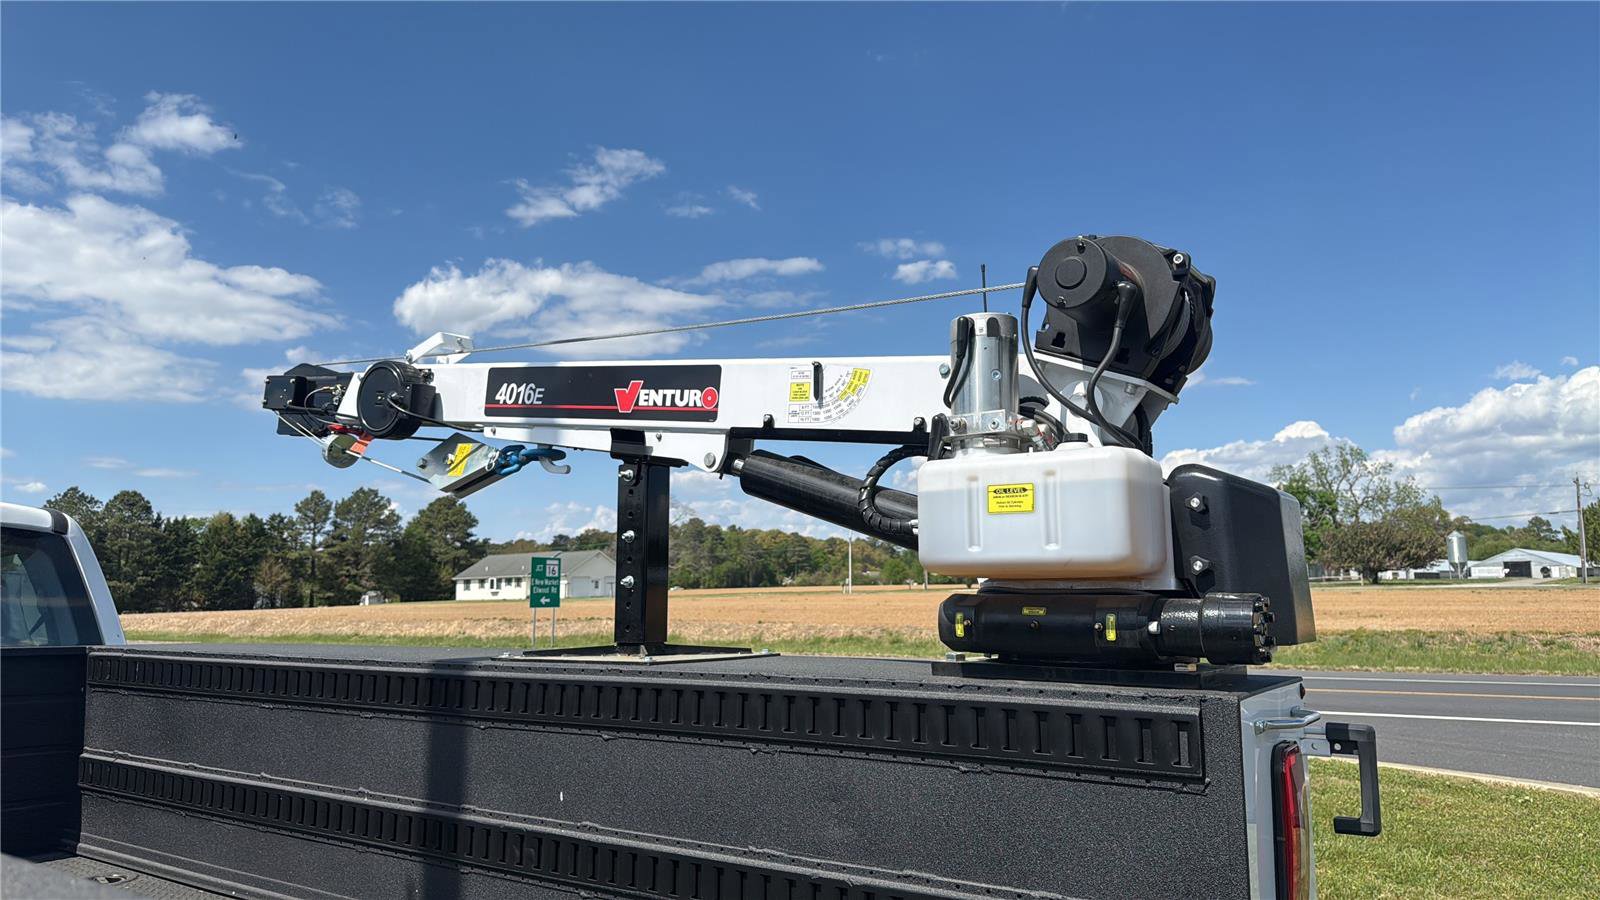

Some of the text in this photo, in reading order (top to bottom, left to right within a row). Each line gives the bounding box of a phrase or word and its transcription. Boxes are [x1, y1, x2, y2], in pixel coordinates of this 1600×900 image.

[495, 383, 544, 404] 4016E
[614, 380, 718, 413] VENTURO
[548, 566, 557, 576] 16
[535, 578, 544, 586] New
[545, 578, 559, 586] Market
[551, 586, 557, 594] Rd
